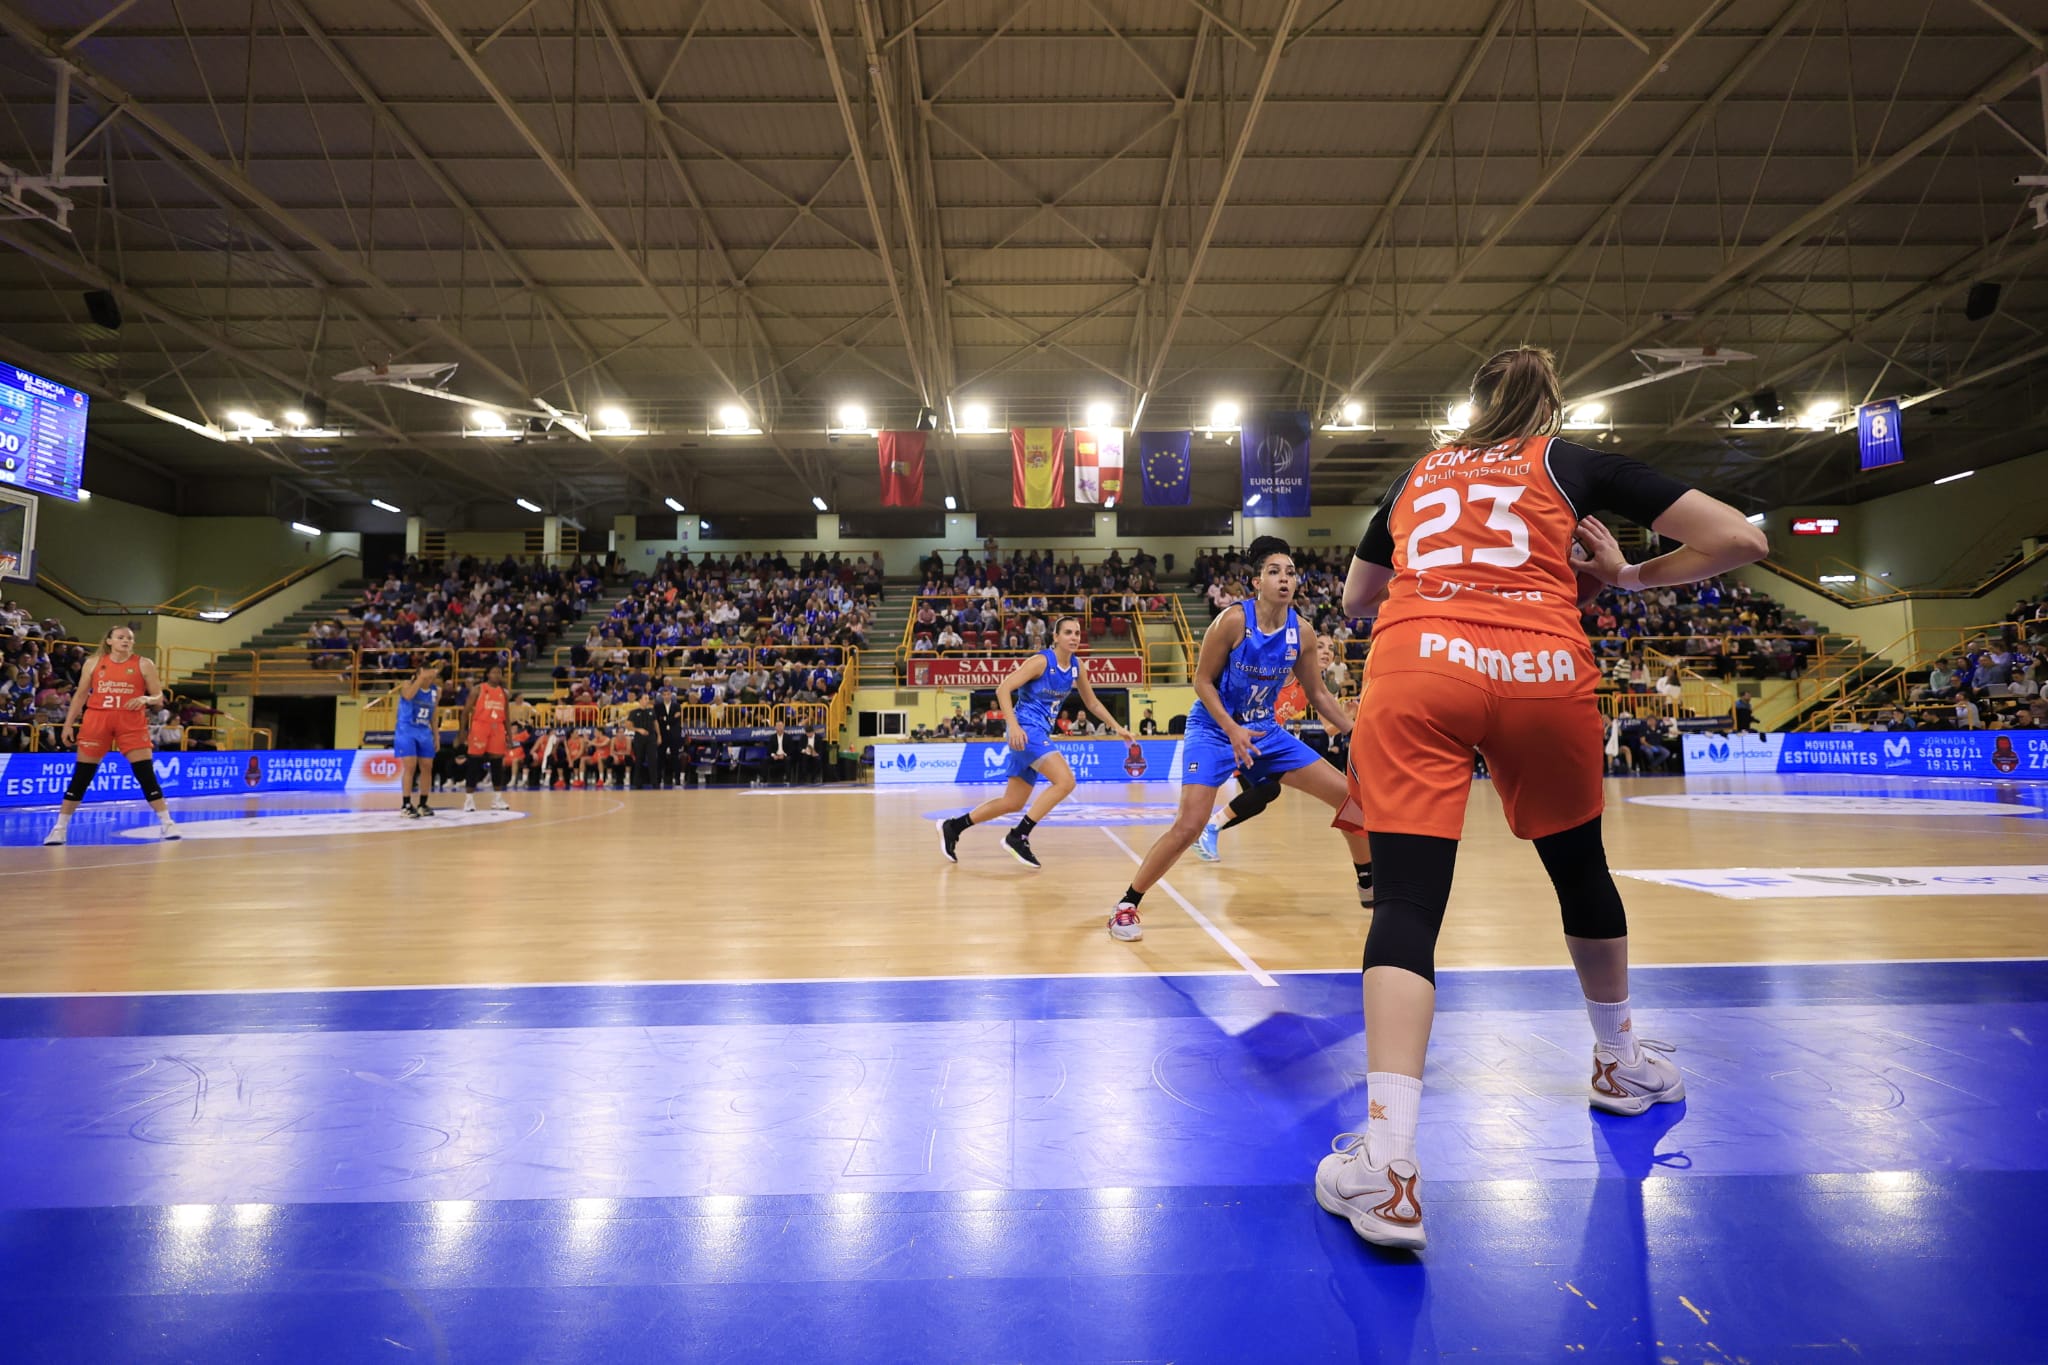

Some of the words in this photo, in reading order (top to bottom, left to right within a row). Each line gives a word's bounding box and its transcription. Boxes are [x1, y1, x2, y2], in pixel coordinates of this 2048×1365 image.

[15, 370, 66, 396] VALENCIA
[24, 382, 57, 401] Basket
[1871, 415, 1888, 439] 8
[1250, 477, 1303, 486] EUROEAGUE
[1407, 484, 1531, 571] 23
[1419, 632, 1576, 683] PAMESA
[958, 659, 1117, 672] SALACA
[934, 673, 1006, 685] PATRIMONI
[103, 696, 121, 709] 21
[1804, 740, 1854, 751] MOVISTAR
[1923, 736, 1967, 746] JORNADA
[1918, 744, 1942, 758] SÁB
[1946, 746, 1983, 759] 18/11
[268, 757, 342, 769] CASADEMONT
[880, 760, 894, 769] LF
[920, 759, 957, 769] endesa
[1784, 751, 1878, 766] ESTUDIANTES
[42, 762, 118, 776] MOVAR
[187, 765, 208, 778] SÁB
[370, 759, 397, 777] tdp
[1927, 760, 1960, 771] 19:15
[267, 768, 343, 783] ZARAGOZA
